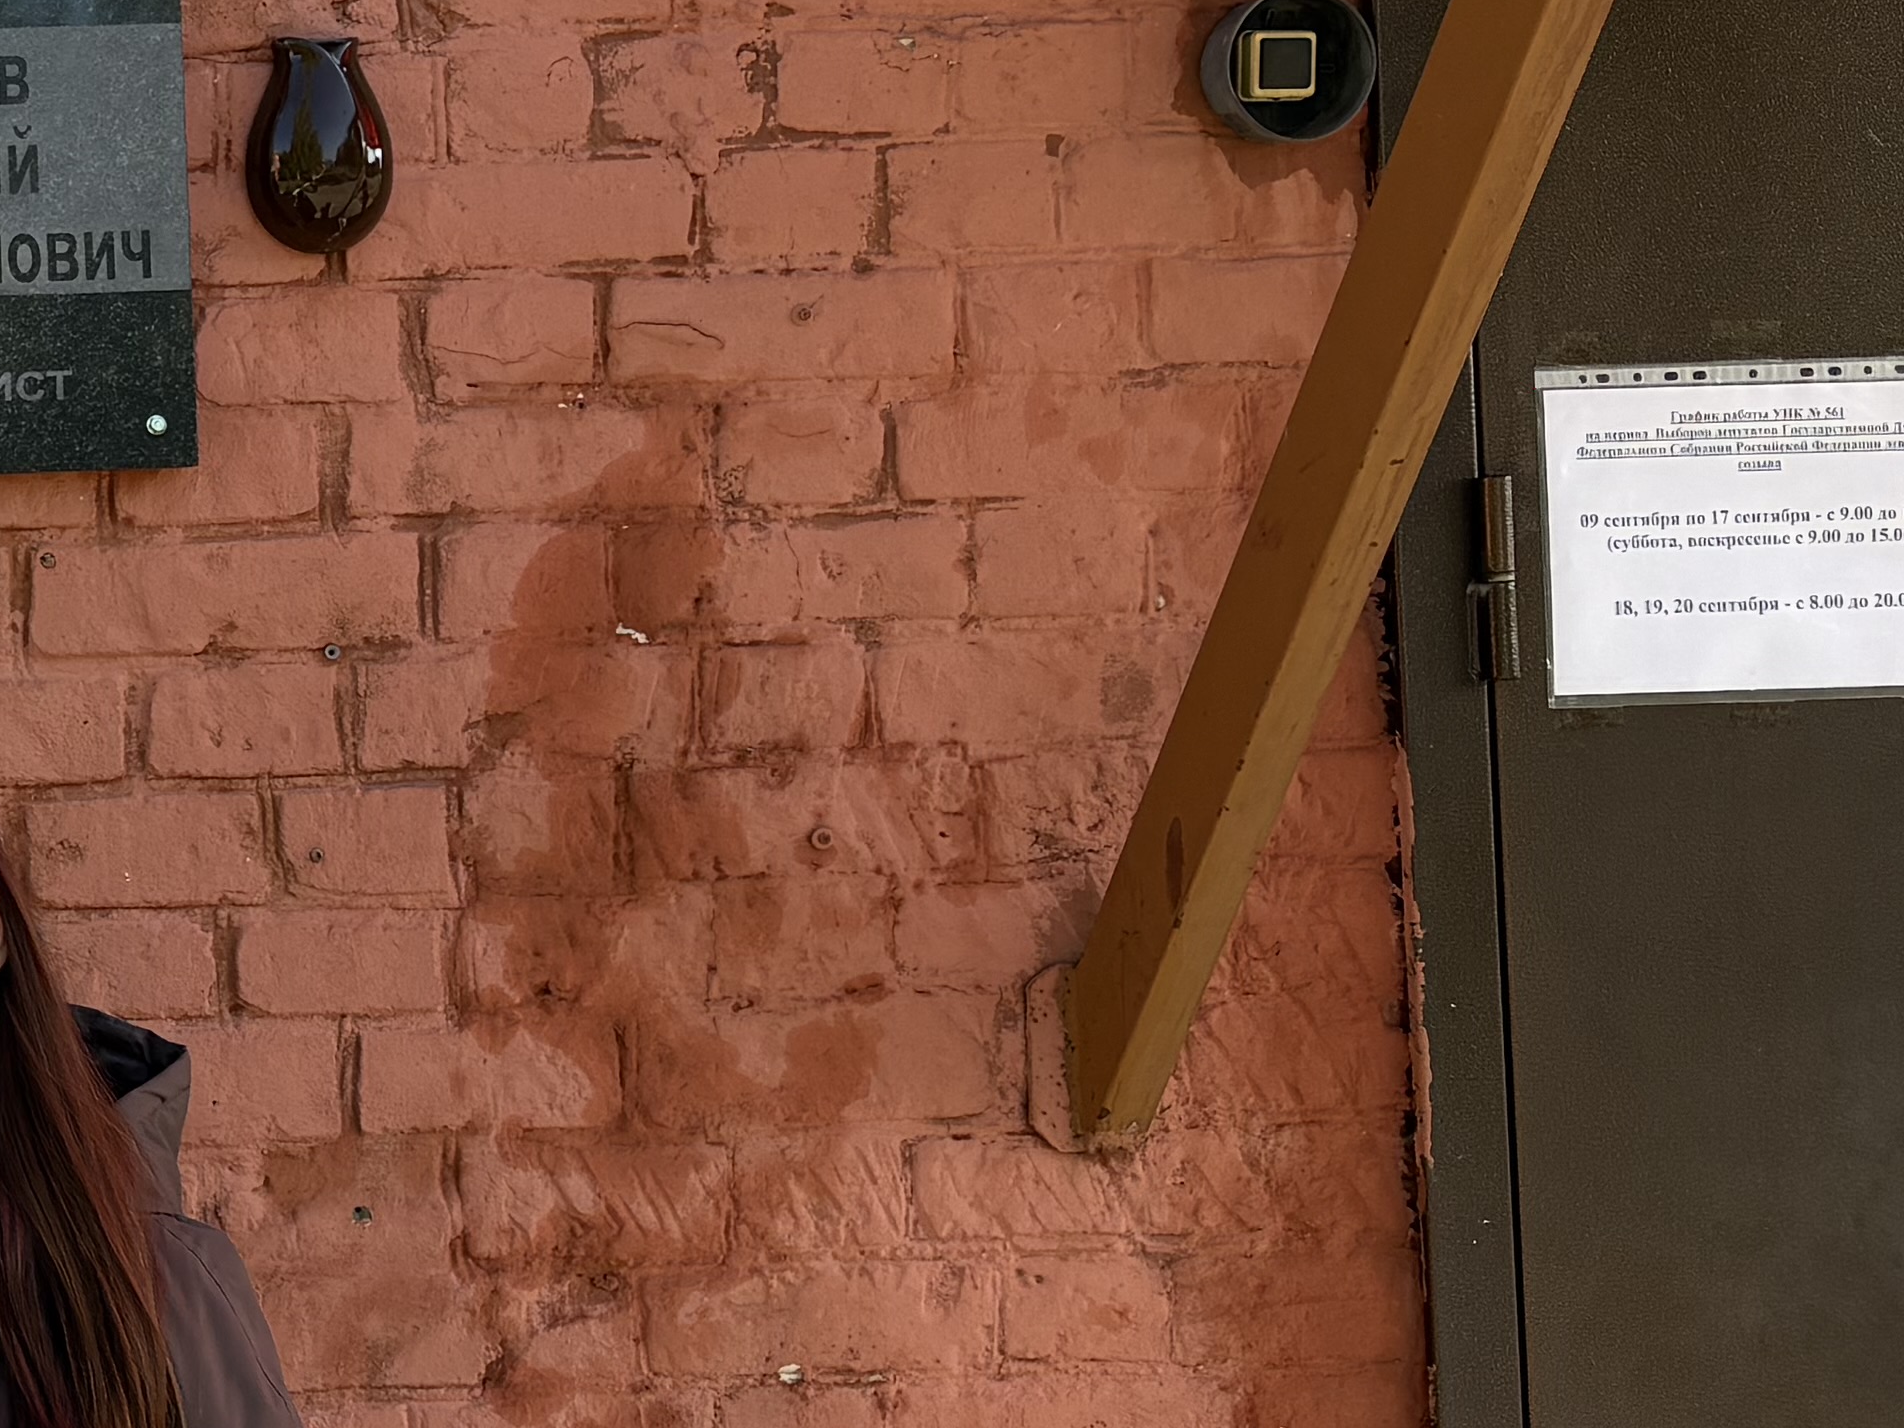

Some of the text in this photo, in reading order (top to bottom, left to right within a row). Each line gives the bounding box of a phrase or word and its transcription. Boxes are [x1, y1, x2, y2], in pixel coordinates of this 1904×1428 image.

[1824, 406, 1845, 419] 561
[1580, 513, 1599, 529] 09
[1603, 511, 1681, 531] сентября
[1686, 513, 1706, 526] по
[1711, 509, 1730, 525] 17
[1734, 508, 1811, 526] сентября
[1826, 510, 1836, 522] с
[1839, 505, 1874, 521] 9.00
[1877, 508, 1897, 521] до
[1607, 533, 1683, 553] (суббота,
[1688, 534, 1791, 551] воскресенье
[1795, 533, 1804, 545] с
[1808, 528, 1841, 545] 9.00
[1844, 531, 1865, 544] до
[1613, 599, 1639, 617] 18,
[1644, 598, 1670, 616] 19,
[1673, 598, 1693, 614] 20
[1698, 596, 1779, 616] сентября
[1795, 598, 1805, 610] с
[1809, 593, 1844, 610] 8.00
[1847, 596, 1869, 610] до
